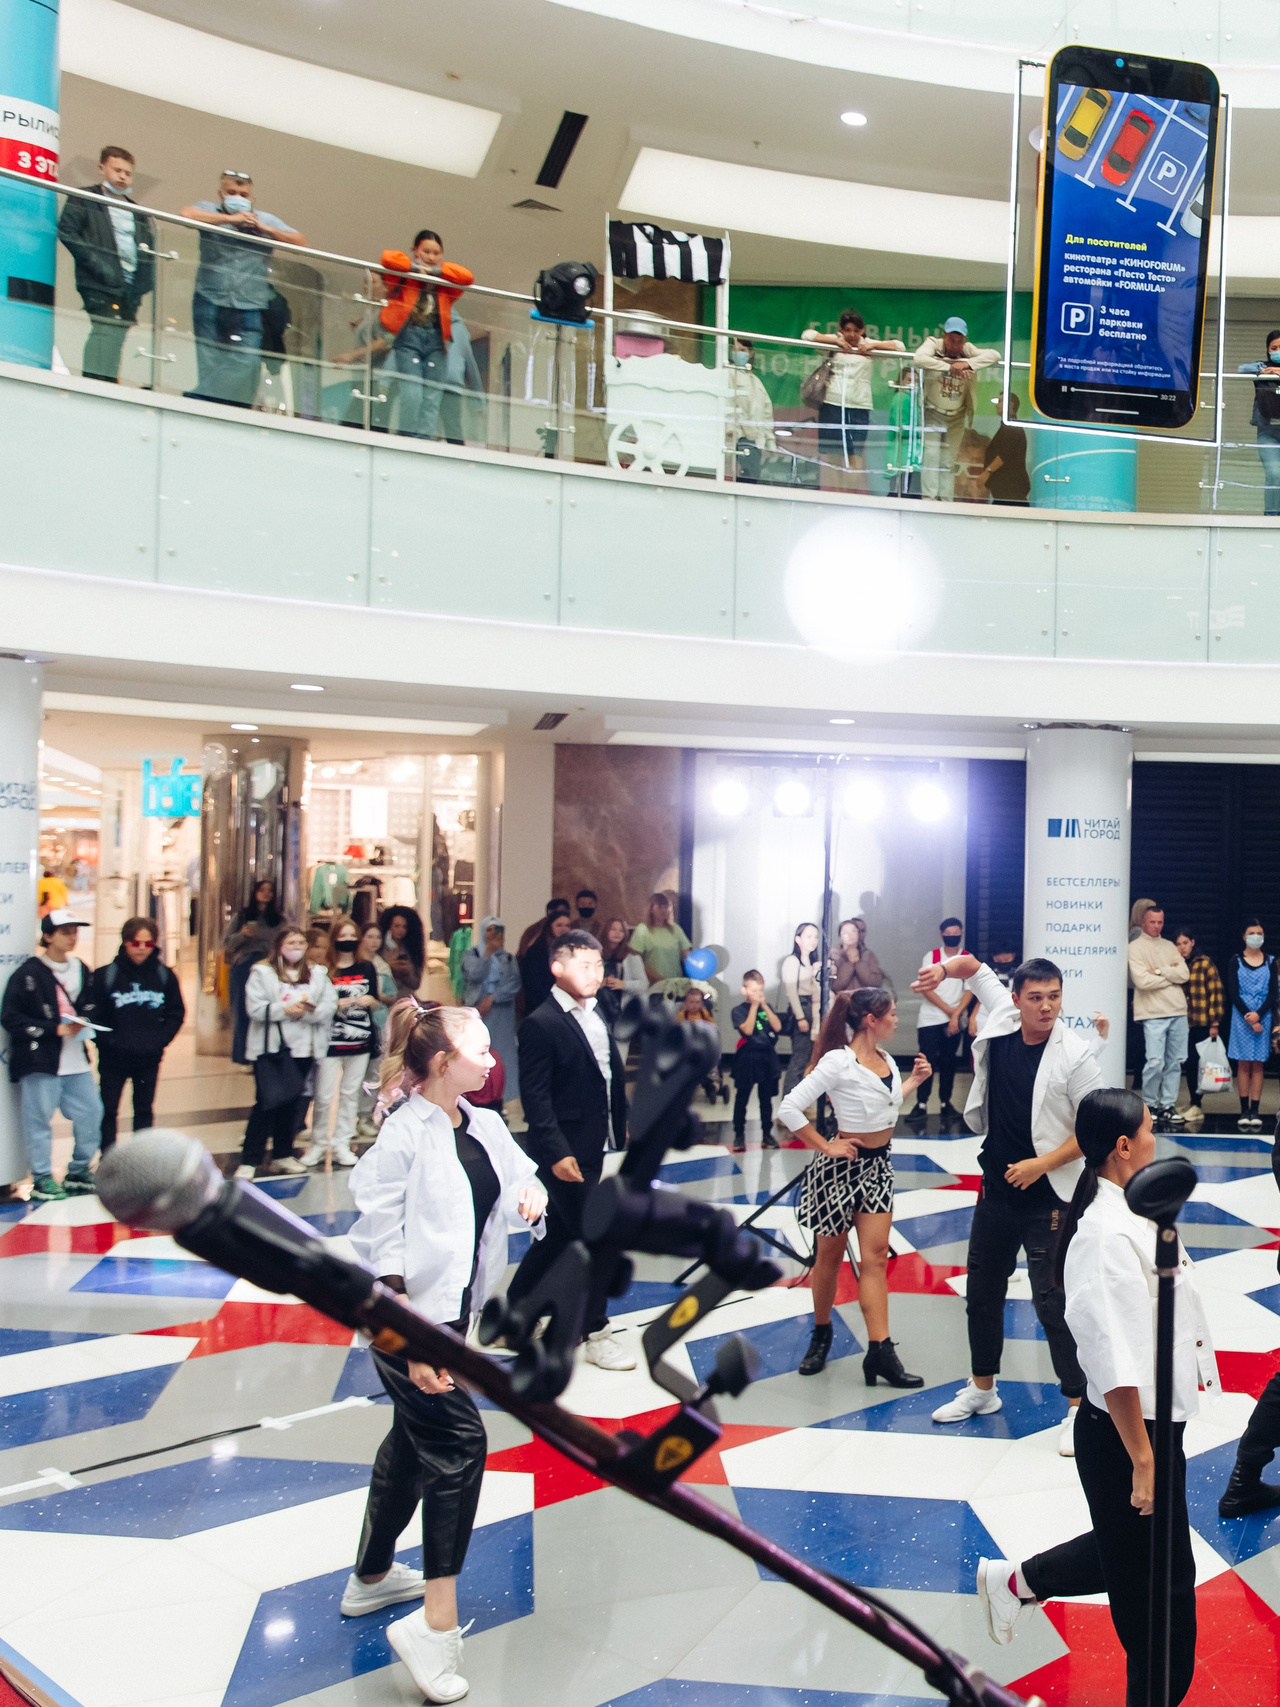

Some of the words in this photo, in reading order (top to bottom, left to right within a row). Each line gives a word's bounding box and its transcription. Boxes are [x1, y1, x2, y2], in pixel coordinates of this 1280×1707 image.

[1065, 234, 1084, 244] Для
[1087, 236, 1147, 251] посетителей
[1064, 252, 1117, 266] кинотеатра
[1063, 264, 1111, 276] ресторана
[1063, 276, 1112, 288] автомойки
[1100, 305, 1107, 314] 3
[1109, 307, 1130, 317] часа
[1099, 318, 1143, 330] парковки
[1098, 328, 1147, 341] бесплатно
[1084, 818, 1120, 829] ЧИТАЙ
[1084, 829, 1120, 840] ГОРОД
[1046, 877, 1120, 887] БЕСТСЕЛЛЕРЫ
[1046, 900, 1103, 910] НОВИНКИ
[1045, 923, 1102, 933] ПОДАРКИ
[1045, 946, 1118, 956] КАНЦЕЛЯРИЯ
[1061, 969, 1083, 978] ИГИ
